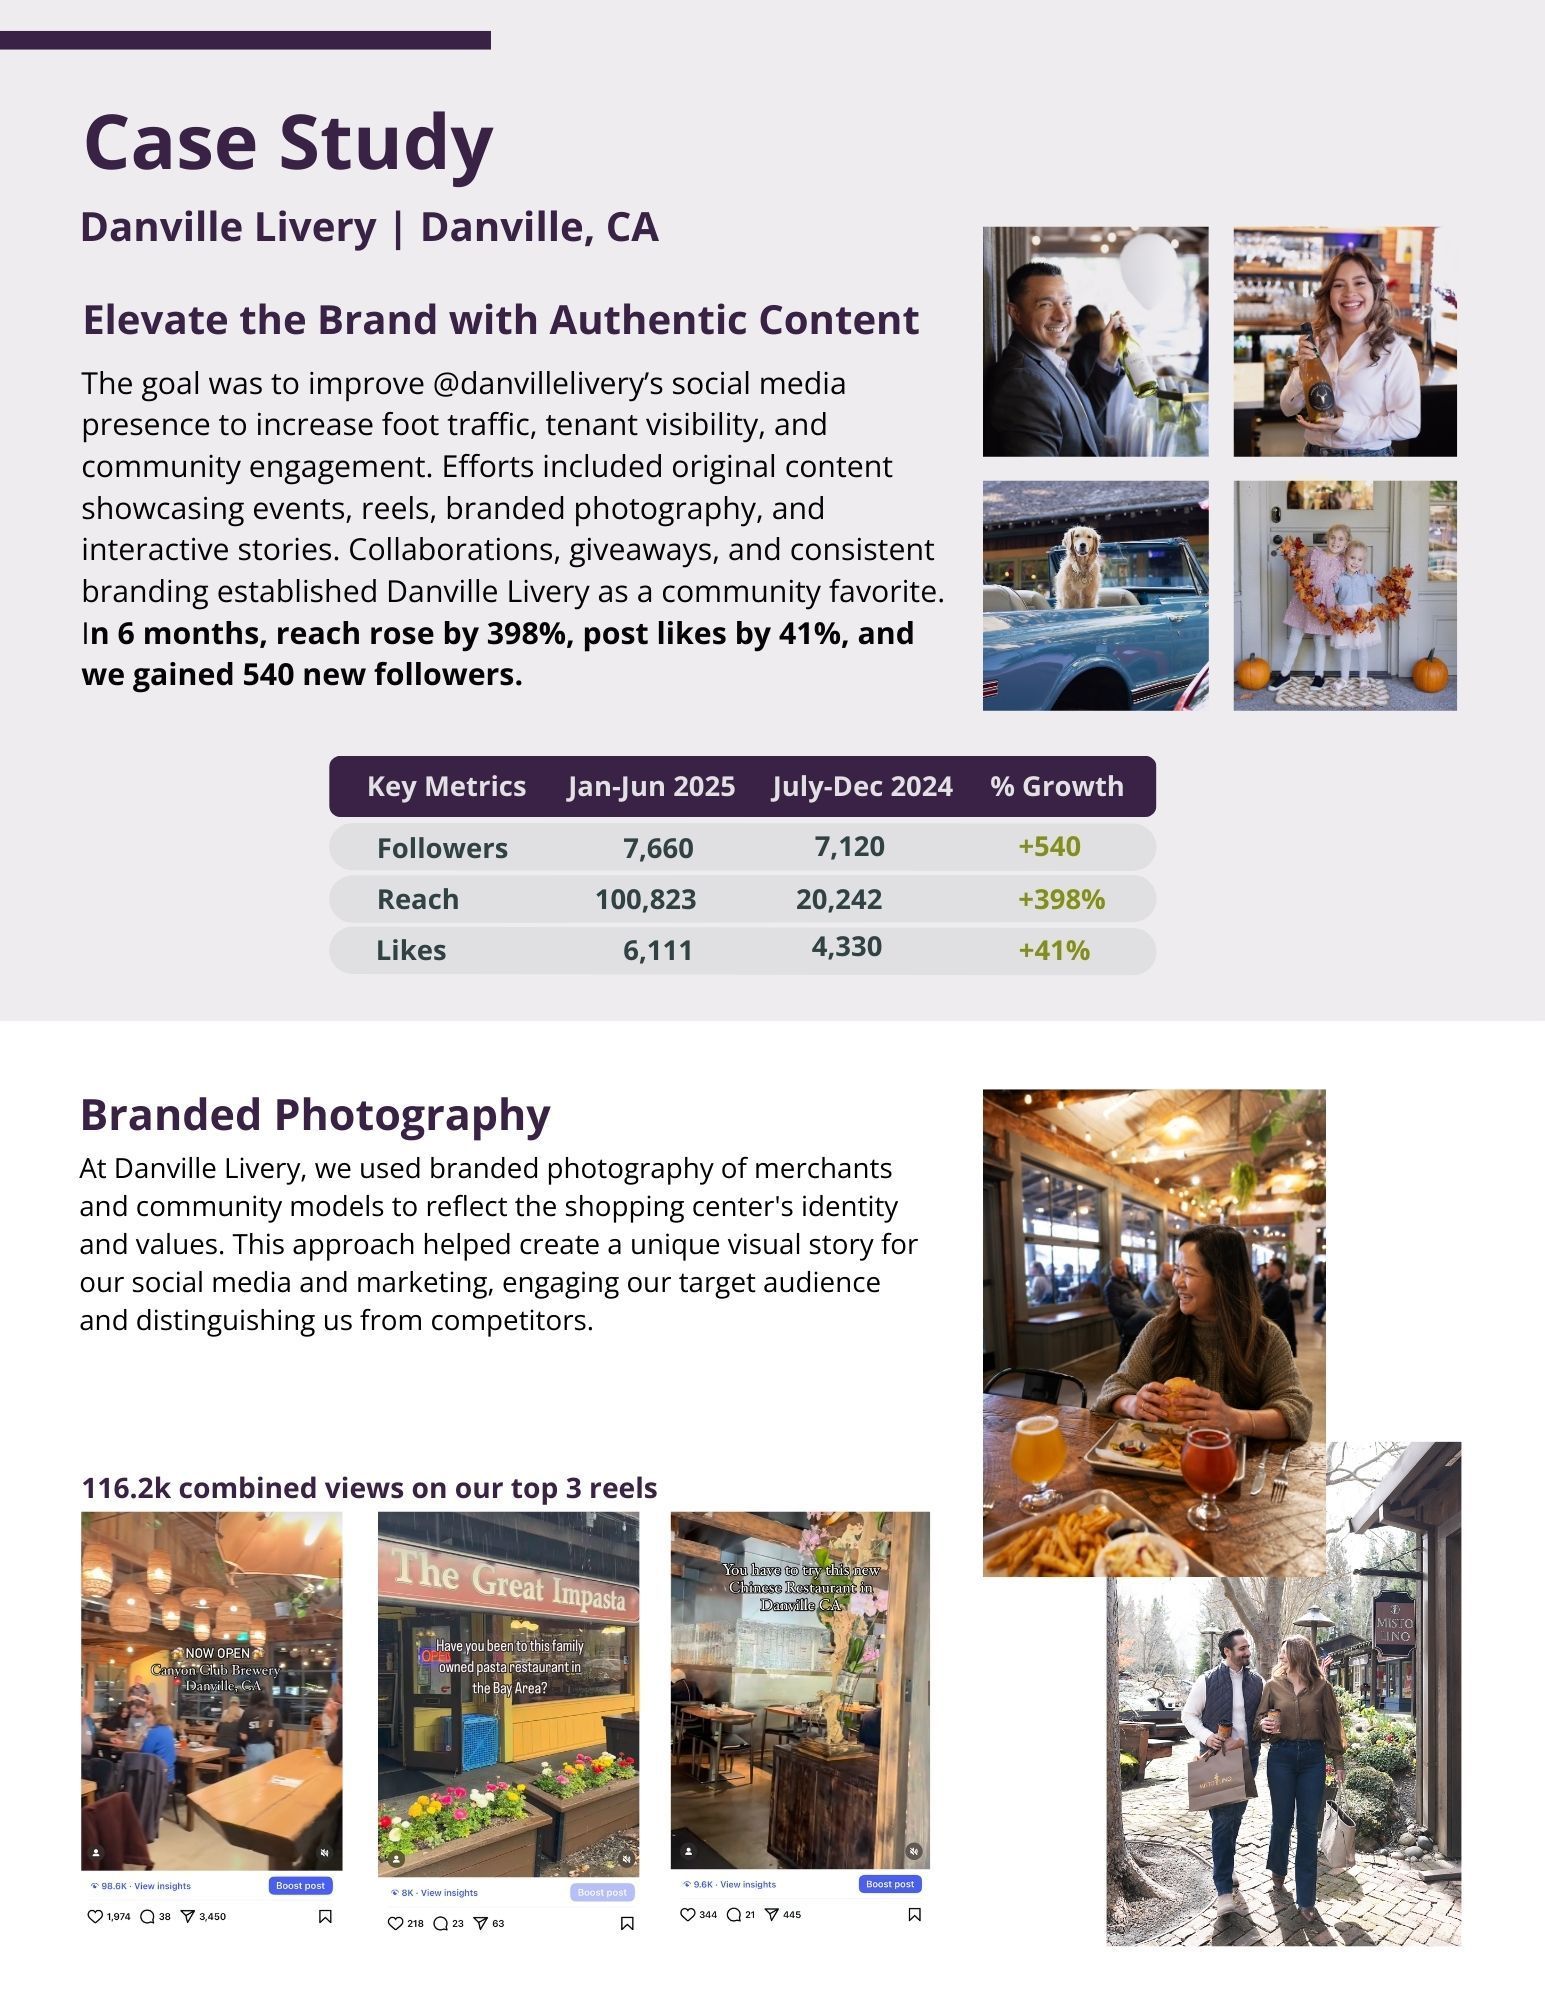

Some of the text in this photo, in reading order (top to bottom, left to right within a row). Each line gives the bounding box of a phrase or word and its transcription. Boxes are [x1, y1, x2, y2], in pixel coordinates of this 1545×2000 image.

[85, 110, 494, 188] Case Study
[82, 209, 660, 252] Danville Livery | Danville, CA
[85, 302, 920, 336] Elevate the Brand with Authentic Content
[80, 370, 133, 396] The
[141, 370, 199, 402] goal
[208, 376, 263, 396] was
[270, 373, 300, 396] to
[309, 371, 425, 402] improve
[672, 370, 750, 396] social
[760, 370, 846, 396] media
[83, 620, 914, 653] In 6 months, reach rose by 398%, post likes by 41%, and
[81, 661, 523, 694] we gained 540 new followers.
[368, 774, 527, 804] Key Metrics
[565, 775, 736, 803] Jan-Jun 2025
[770, 774, 954, 804] July-Dec 2024
[990, 774, 1124, 798] % Growth
[378, 836, 509, 859] Followers
[623, 837, 694, 863] 7,660
[814, 835, 885, 861] 7,120
[1018, 835, 1081, 857] +540
[378, 887, 459, 910] Reach
[595, 888, 697, 914] 100,823
[796, 888, 883, 914] 20,242
[1018, 888, 1106, 911] +398%
[377, 938, 447, 961] Likes
[623, 939, 691, 965] 6,111
[811, 935, 883, 961] 4,330
[1019, 939, 1091, 961] +41%
[82, 1096, 552, 1142] Branded Photography
[78, 1156, 893, 1186] At Danville Livery, we used branded photography of merchants
[79, 1194, 899, 1224] and community models to reflect the shopping center's identity
[82, 1475, 658, 1506] 116.2k combined views on our top 3 reels
[392, 1548, 626, 1613] The Great Impasta
[1376, 1618, 1414, 1629] MISTO
[101, 1881, 192, 1892] 98.6K View insights
[276, 1881, 326, 1892] Boost post
[401, 1888, 479, 1899] 8K View insights
[577, 1888, 627, 1898] Boost post
[693, 1880, 777, 1890] 9.6K View insights
[866, 1880, 916, 1892] Boost post
[106, 1912, 131, 1923] 1,974
[158, 1912, 172, 1921] 38
[199, 1912, 227, 1923] 3,450
[407, 1919, 425, 1928] 218
[452, 1919, 465, 1928] 23
[492, 1919, 505, 1928] 63
[699, 1910, 718, 1919] 344
[745, 1910, 755, 1919] 21
[782, 1910, 802, 1919] 445
